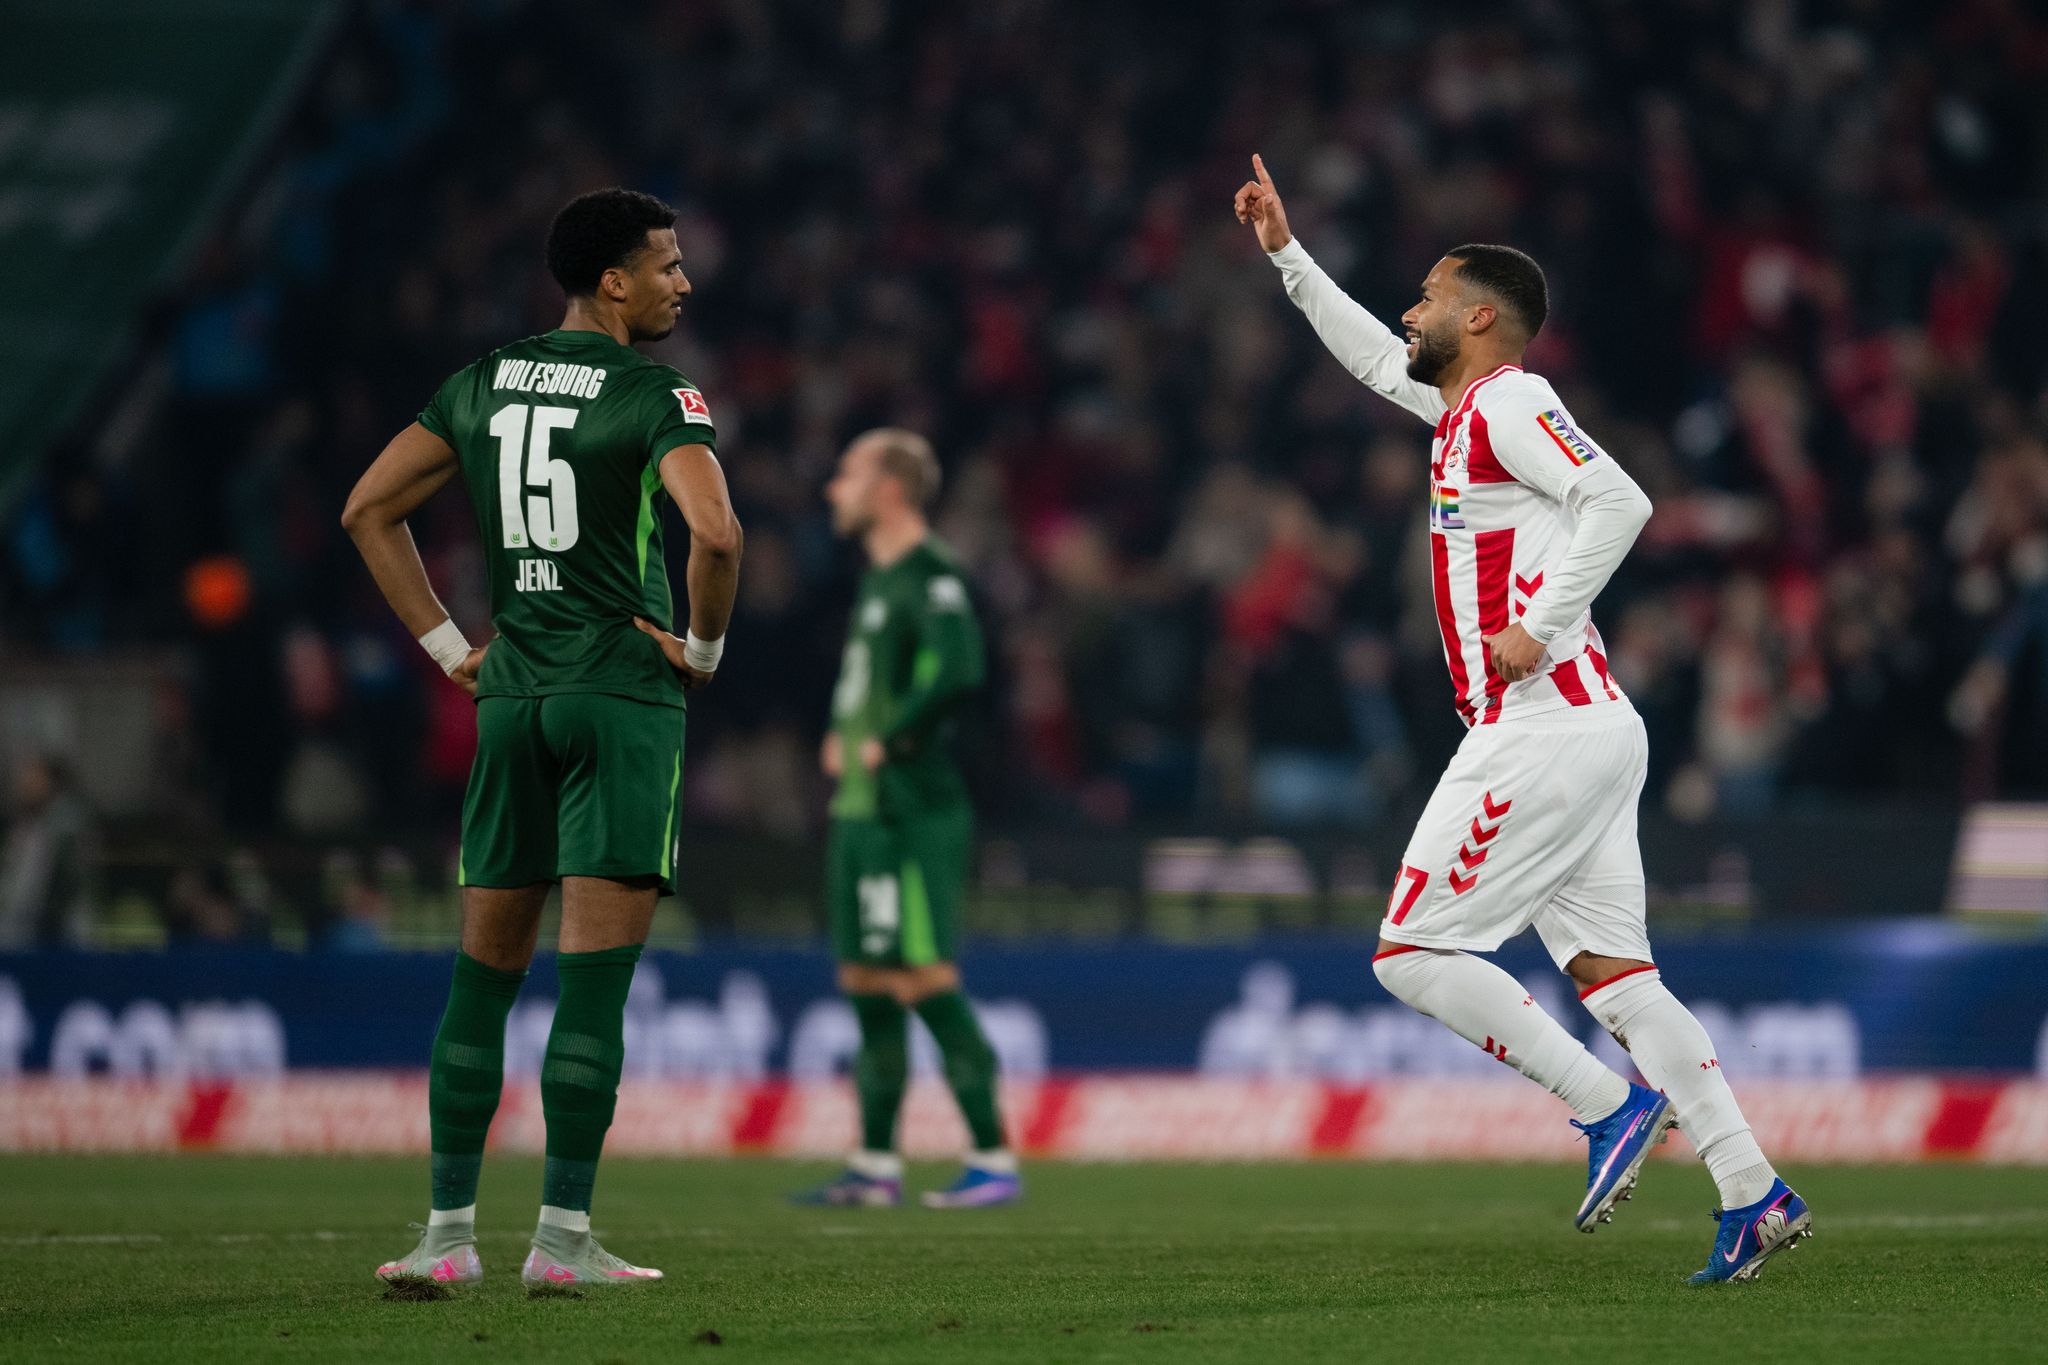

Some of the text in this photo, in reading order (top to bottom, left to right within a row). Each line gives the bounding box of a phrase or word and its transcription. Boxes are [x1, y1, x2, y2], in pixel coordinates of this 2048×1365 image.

[493, 359, 607, 399] WOLFSBURG
[1546, 415, 1590, 460] DEVK
[489, 403, 579, 552] 15
[515, 559, 563, 592] JENZ
[1385, 864, 1430, 926] 7
